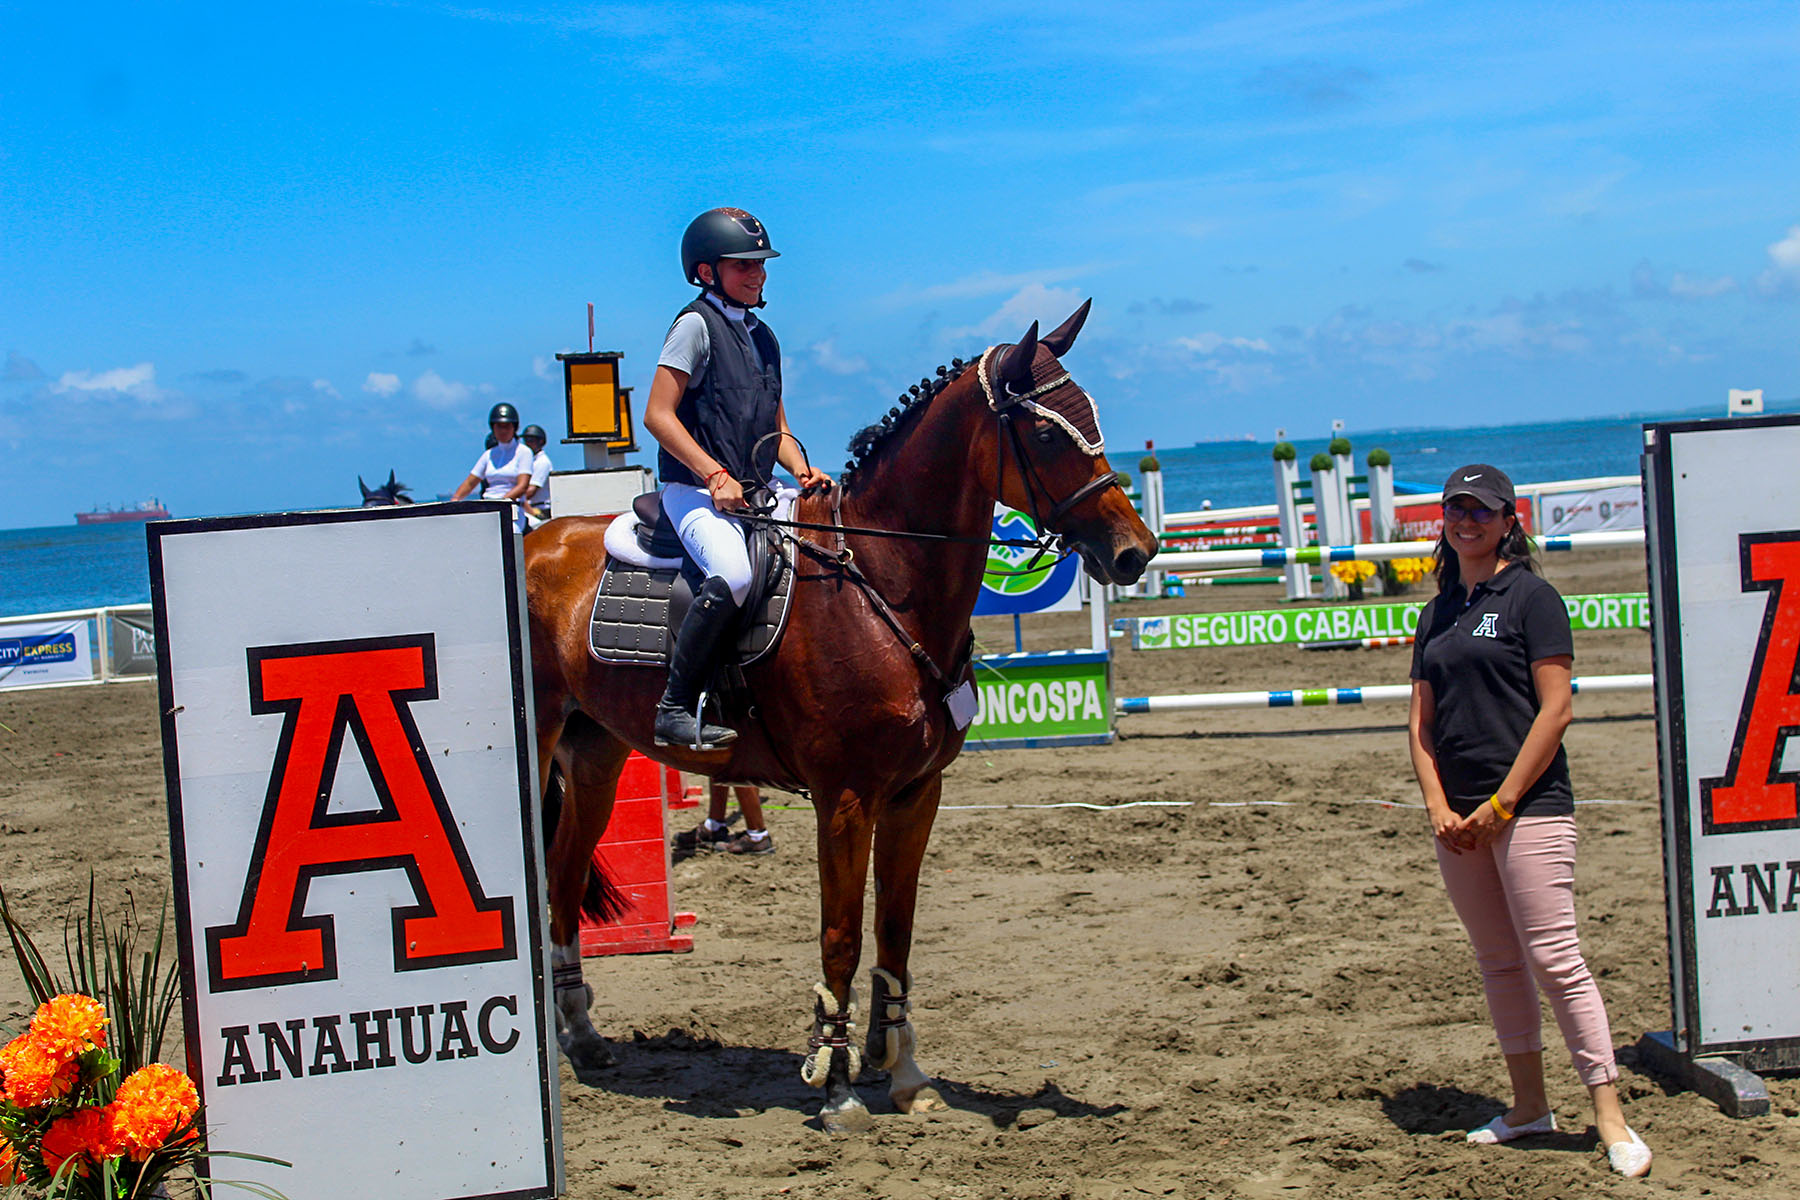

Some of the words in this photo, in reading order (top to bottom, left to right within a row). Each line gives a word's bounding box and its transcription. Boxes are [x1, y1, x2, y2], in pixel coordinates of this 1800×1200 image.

[1175, 613, 1288, 648] SEGURO
[1294, 606, 1421, 642] CABALLO
[1472, 612, 1499, 638] A
[0, 646, 20, 660] ITY
[23, 642, 74, 658] EXPRESS
[205, 632, 518, 994] A
[216, 994, 521, 1087] ANAHUAC
